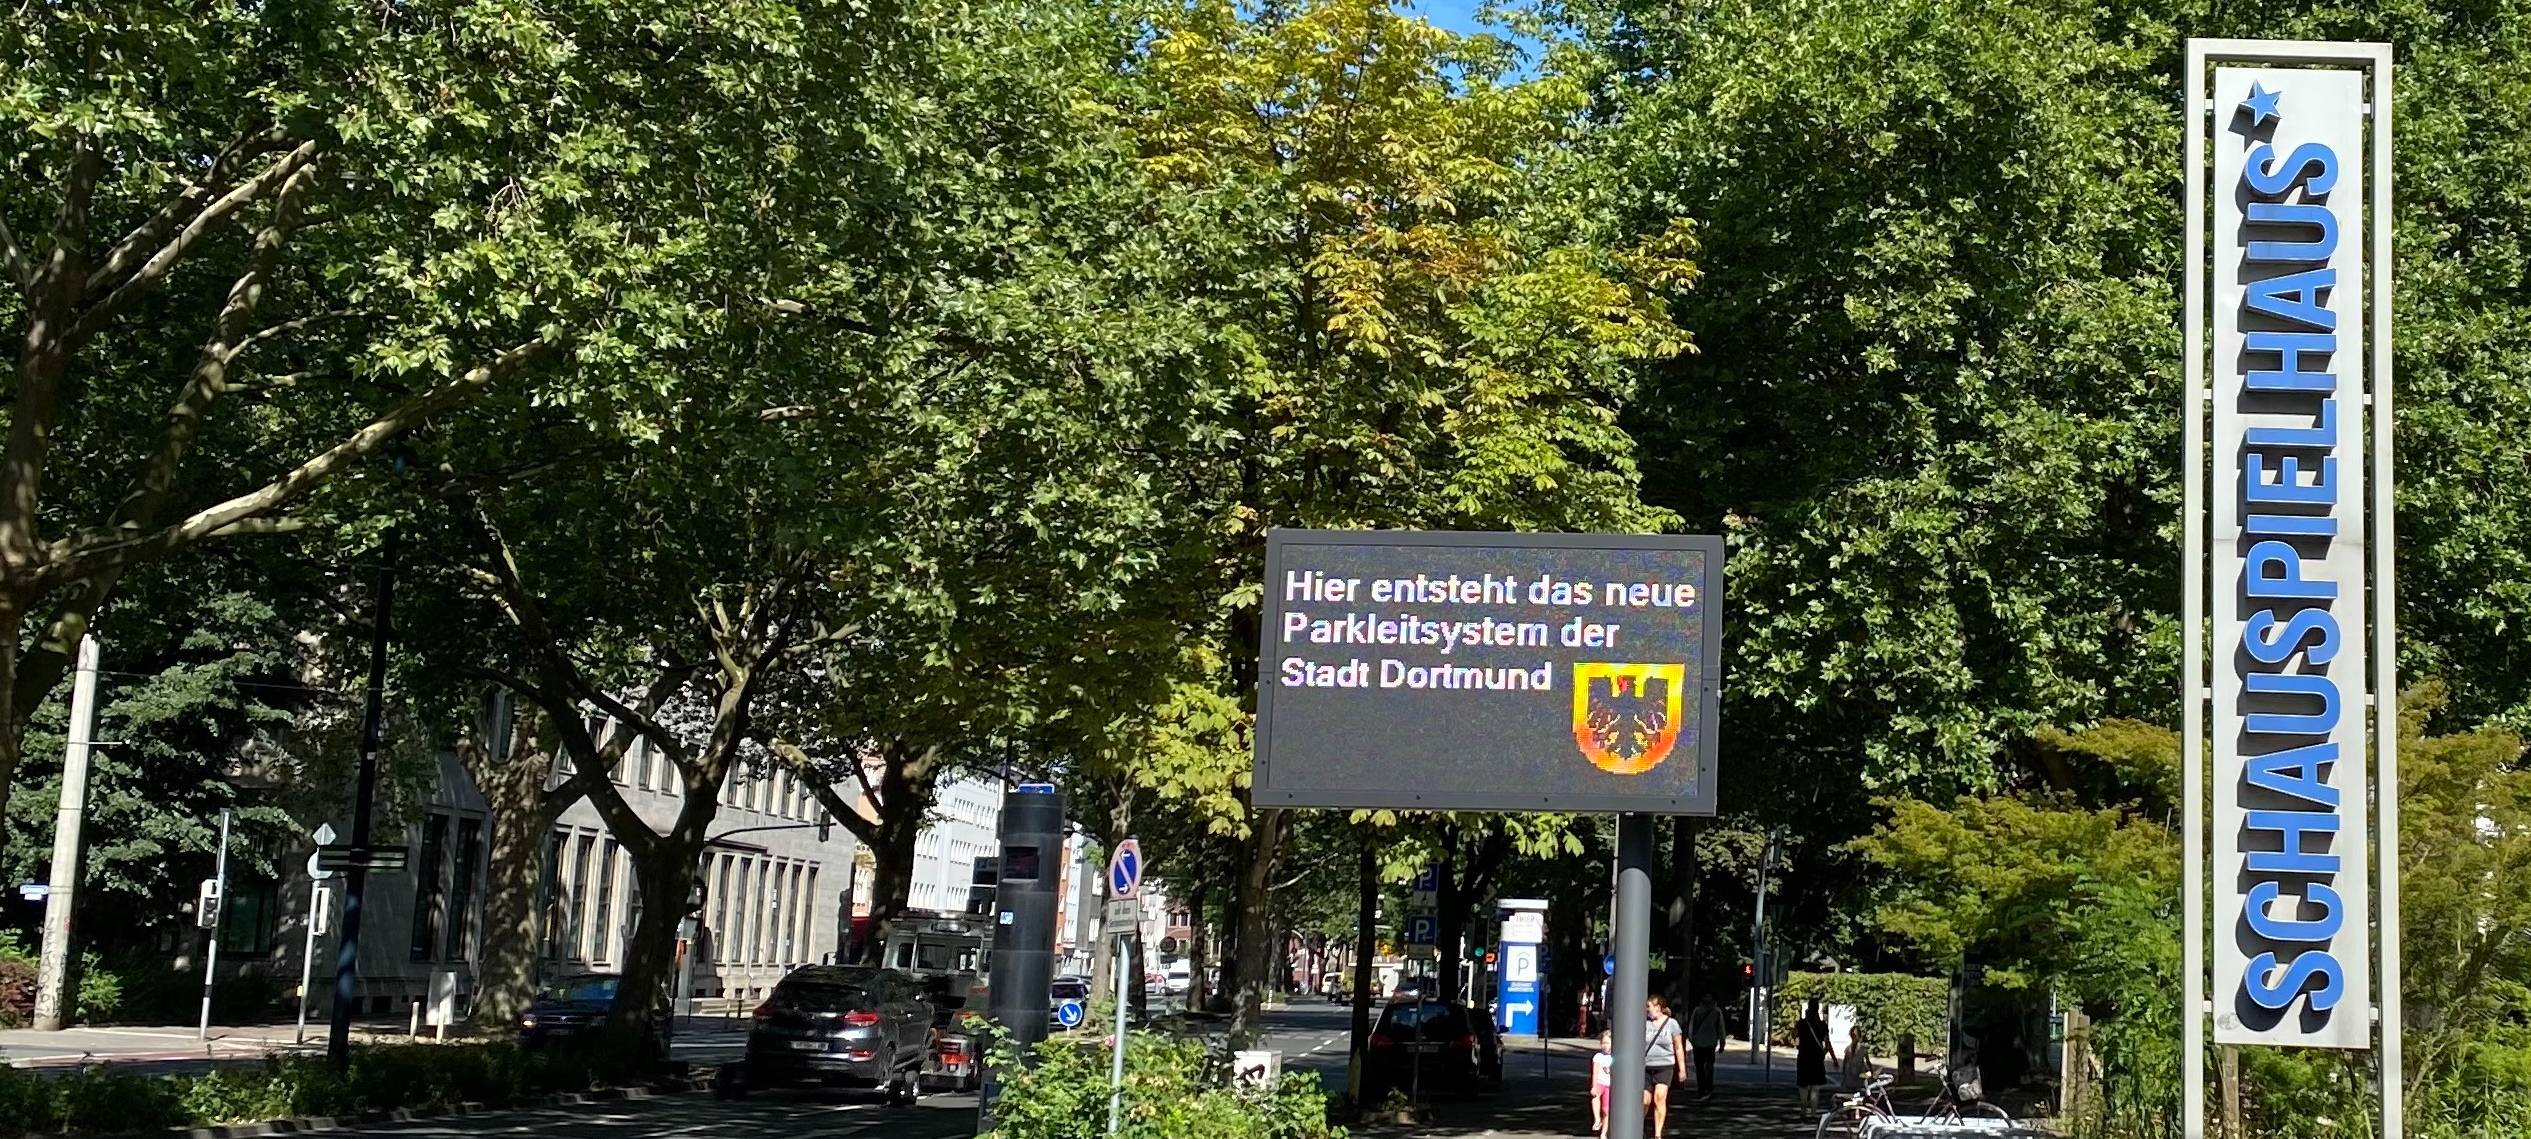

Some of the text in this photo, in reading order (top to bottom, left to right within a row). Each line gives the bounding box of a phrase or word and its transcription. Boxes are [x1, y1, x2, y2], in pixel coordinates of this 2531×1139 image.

[1285, 570, 1697, 607] Hier entsteht das neue
[2243, 140, 2344, 1013] SCHAUSPIELHAUS
[1282, 612, 1620, 654] Parkleitsystem der
[1280, 657, 1552, 691] Stadt Dortmund
[1415, 920, 1430, 942] P
